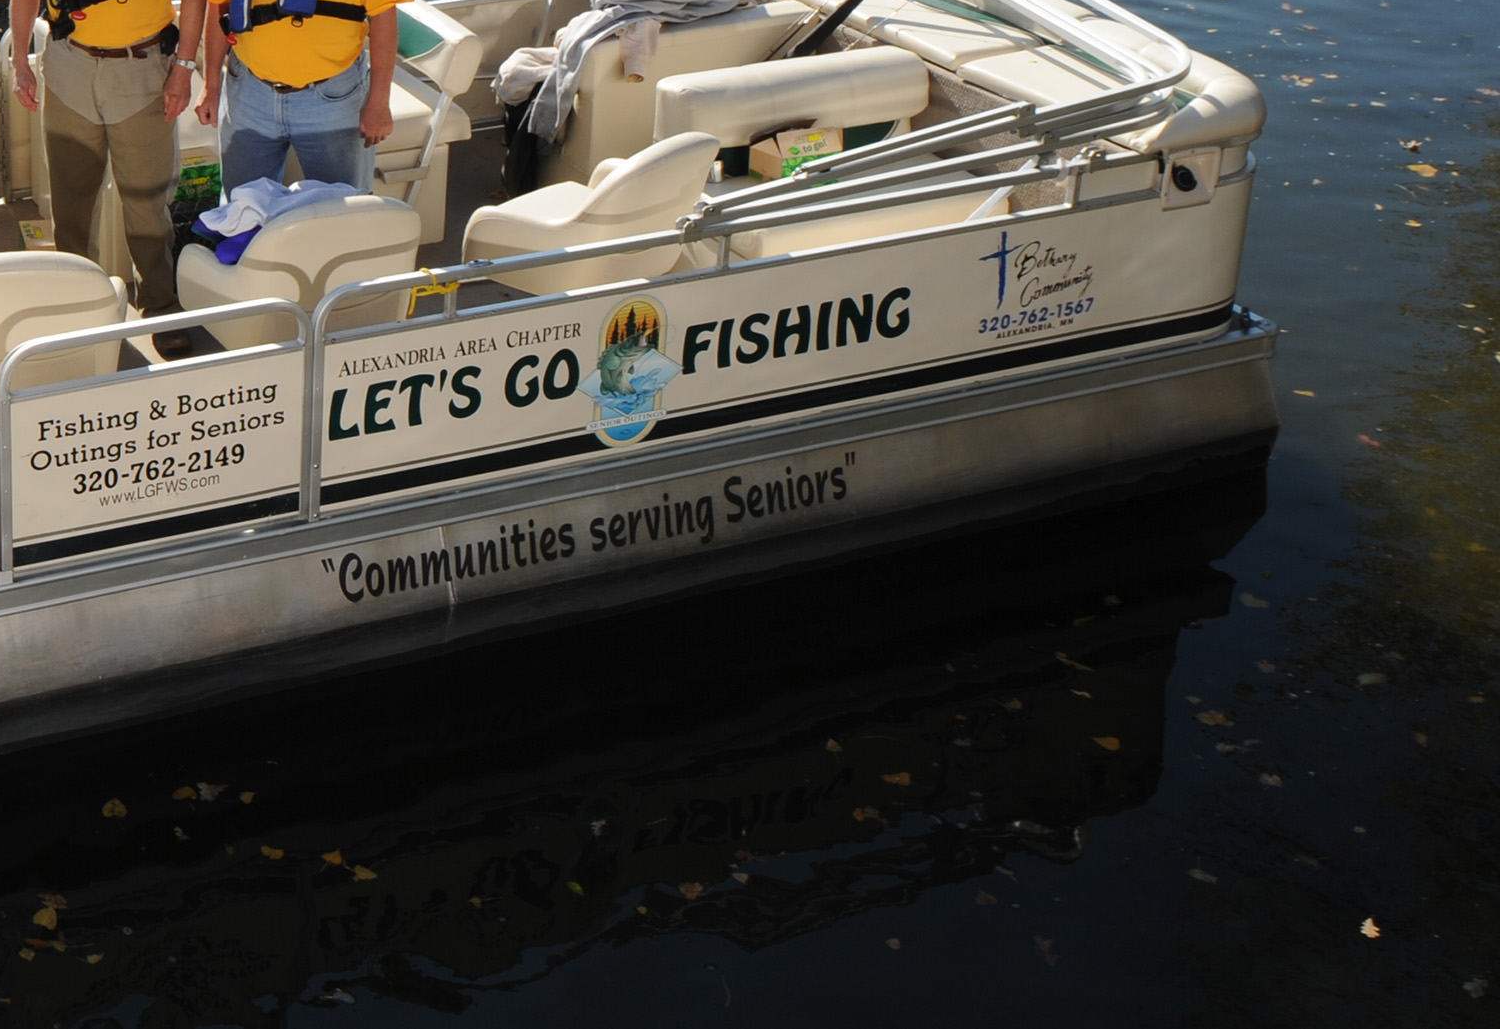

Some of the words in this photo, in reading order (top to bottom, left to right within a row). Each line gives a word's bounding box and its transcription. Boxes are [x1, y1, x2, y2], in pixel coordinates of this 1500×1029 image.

[1014, 240, 1078, 282] Bethany
[1019, 264, 1093, 309] Community
[978, 296, 1095, 334] 320-762-1567
[995, 322, 1056, 340] ALEXANDRIA,
[1059, 317, 1074, 327] MN
[328, 365, 483, 442] LET'S
[504, 347, 581, 409] GO
[681, 286, 911, 375] FISHING
[337, 344, 446, 378] ALEXANDRIA
[453, 337, 498, 359] AREA
[506, 322, 582, 349] CHAPTER
[37, 410, 139, 442] Fishing
[149, 399, 168, 421] &
[177, 383, 278, 416] Boating
[589, 417, 622, 430] SENIOR
[623, 411, 664, 423] OUTINGS
[30, 437, 137, 471] Outings
[146, 430, 181, 450] for
[190, 409, 285, 442] Seniors
[72, 443, 246, 496] 320-762-2149
[99, 473, 221, 507] www.LGFWS.com
[321, 518, 576, 603] "Communities
[590, 492, 716, 545] serving
[724, 451, 857, 523] Seniors"
